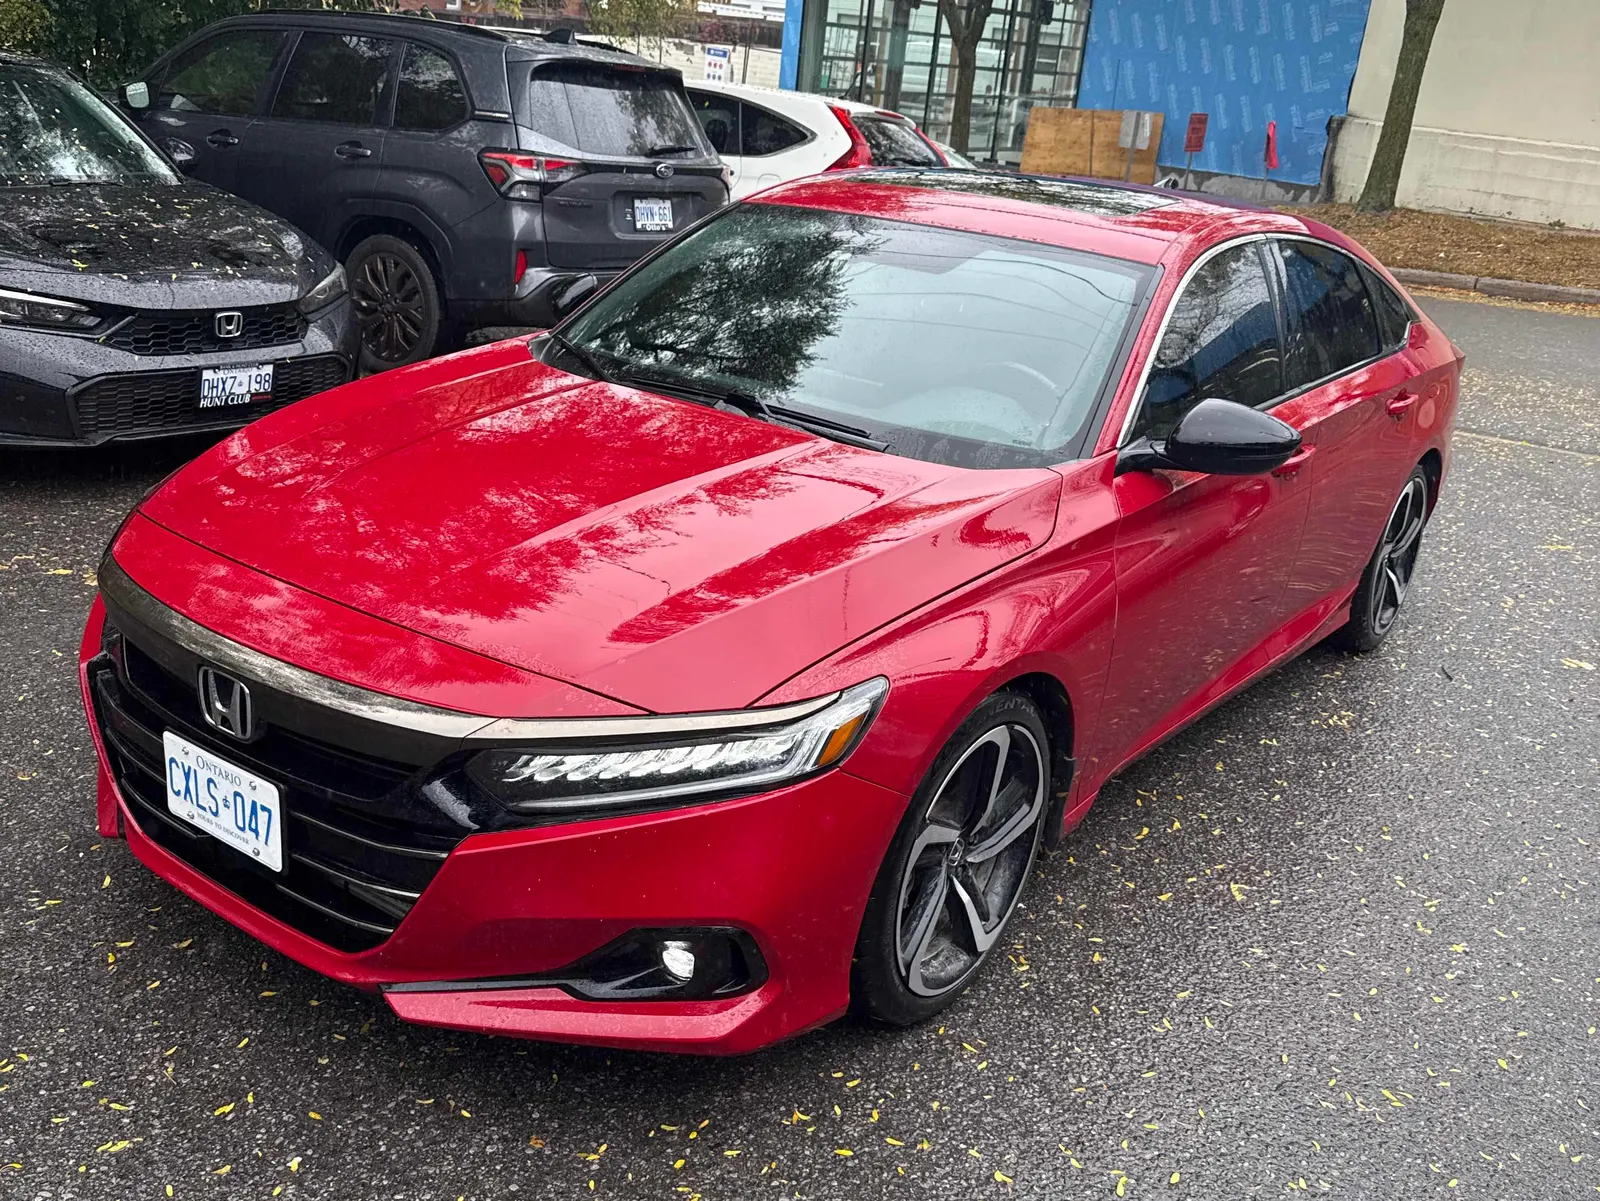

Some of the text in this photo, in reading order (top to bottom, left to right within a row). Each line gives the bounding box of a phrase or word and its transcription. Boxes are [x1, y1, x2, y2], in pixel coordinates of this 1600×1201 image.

[200, 396, 227, 408] HUNT
[228, 394, 251, 405] CLUB
[168, 756, 220, 817] CXLS
[196, 755, 242, 787] ONTARIO
[196, 811, 250, 846] YOURS TO DISCOVER
